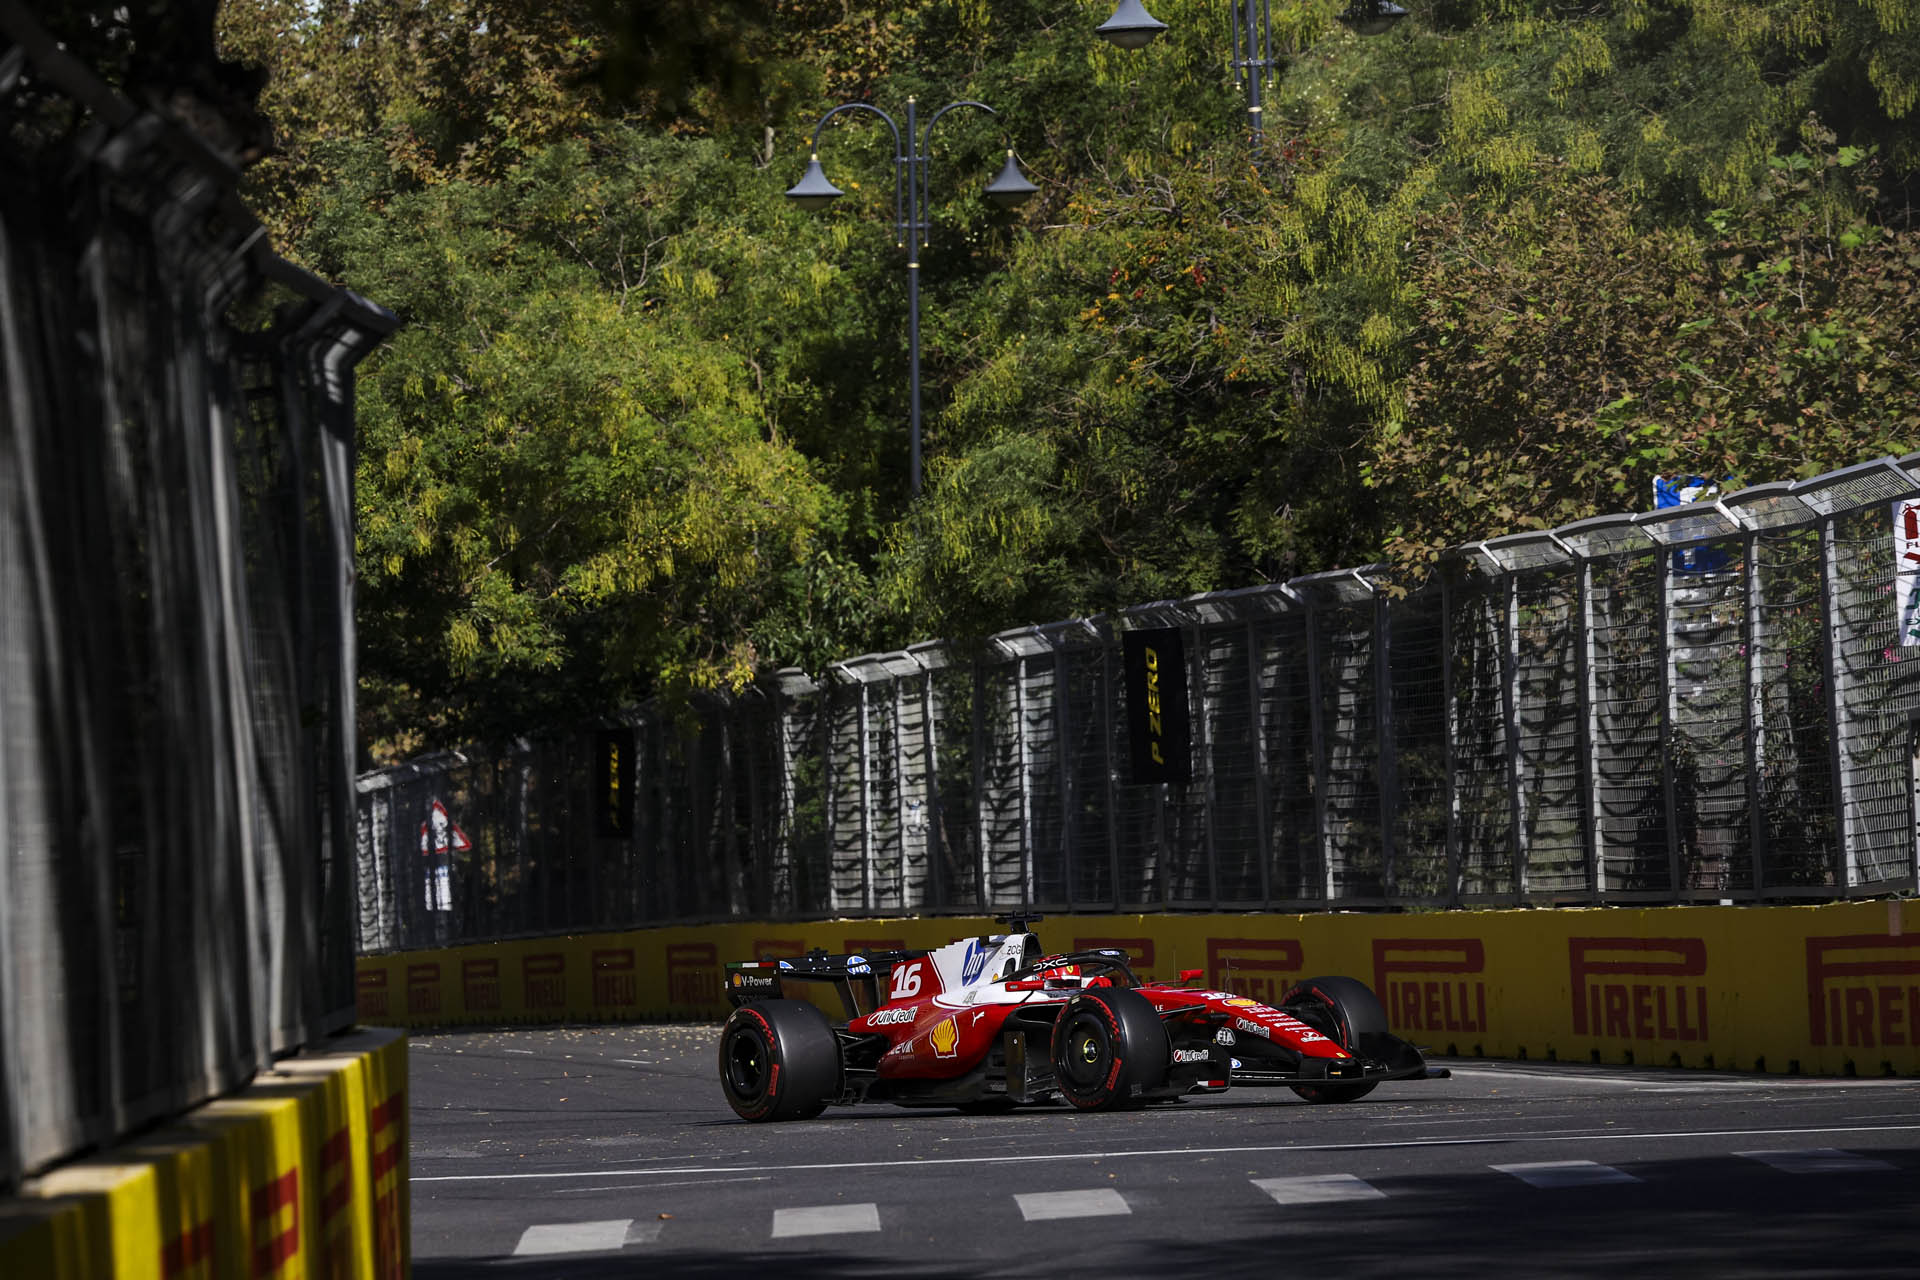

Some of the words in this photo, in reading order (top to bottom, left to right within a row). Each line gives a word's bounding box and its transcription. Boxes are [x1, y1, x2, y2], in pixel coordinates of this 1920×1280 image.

[1145, 648, 1162, 737] ZERO
[1151, 741, 1164, 765] P
[891, 963, 921, 999] 16
[963, 940, 985, 986] hp
[741, 976, 772, 987] V-Power
[1373, 938, 1488, 1032] PIRELLI
[1568, 937, 1710, 1042] PIRELLI
[879, 1007, 918, 1024] UniCredit
[1182, 1050, 1208, 1062] UniCredit
